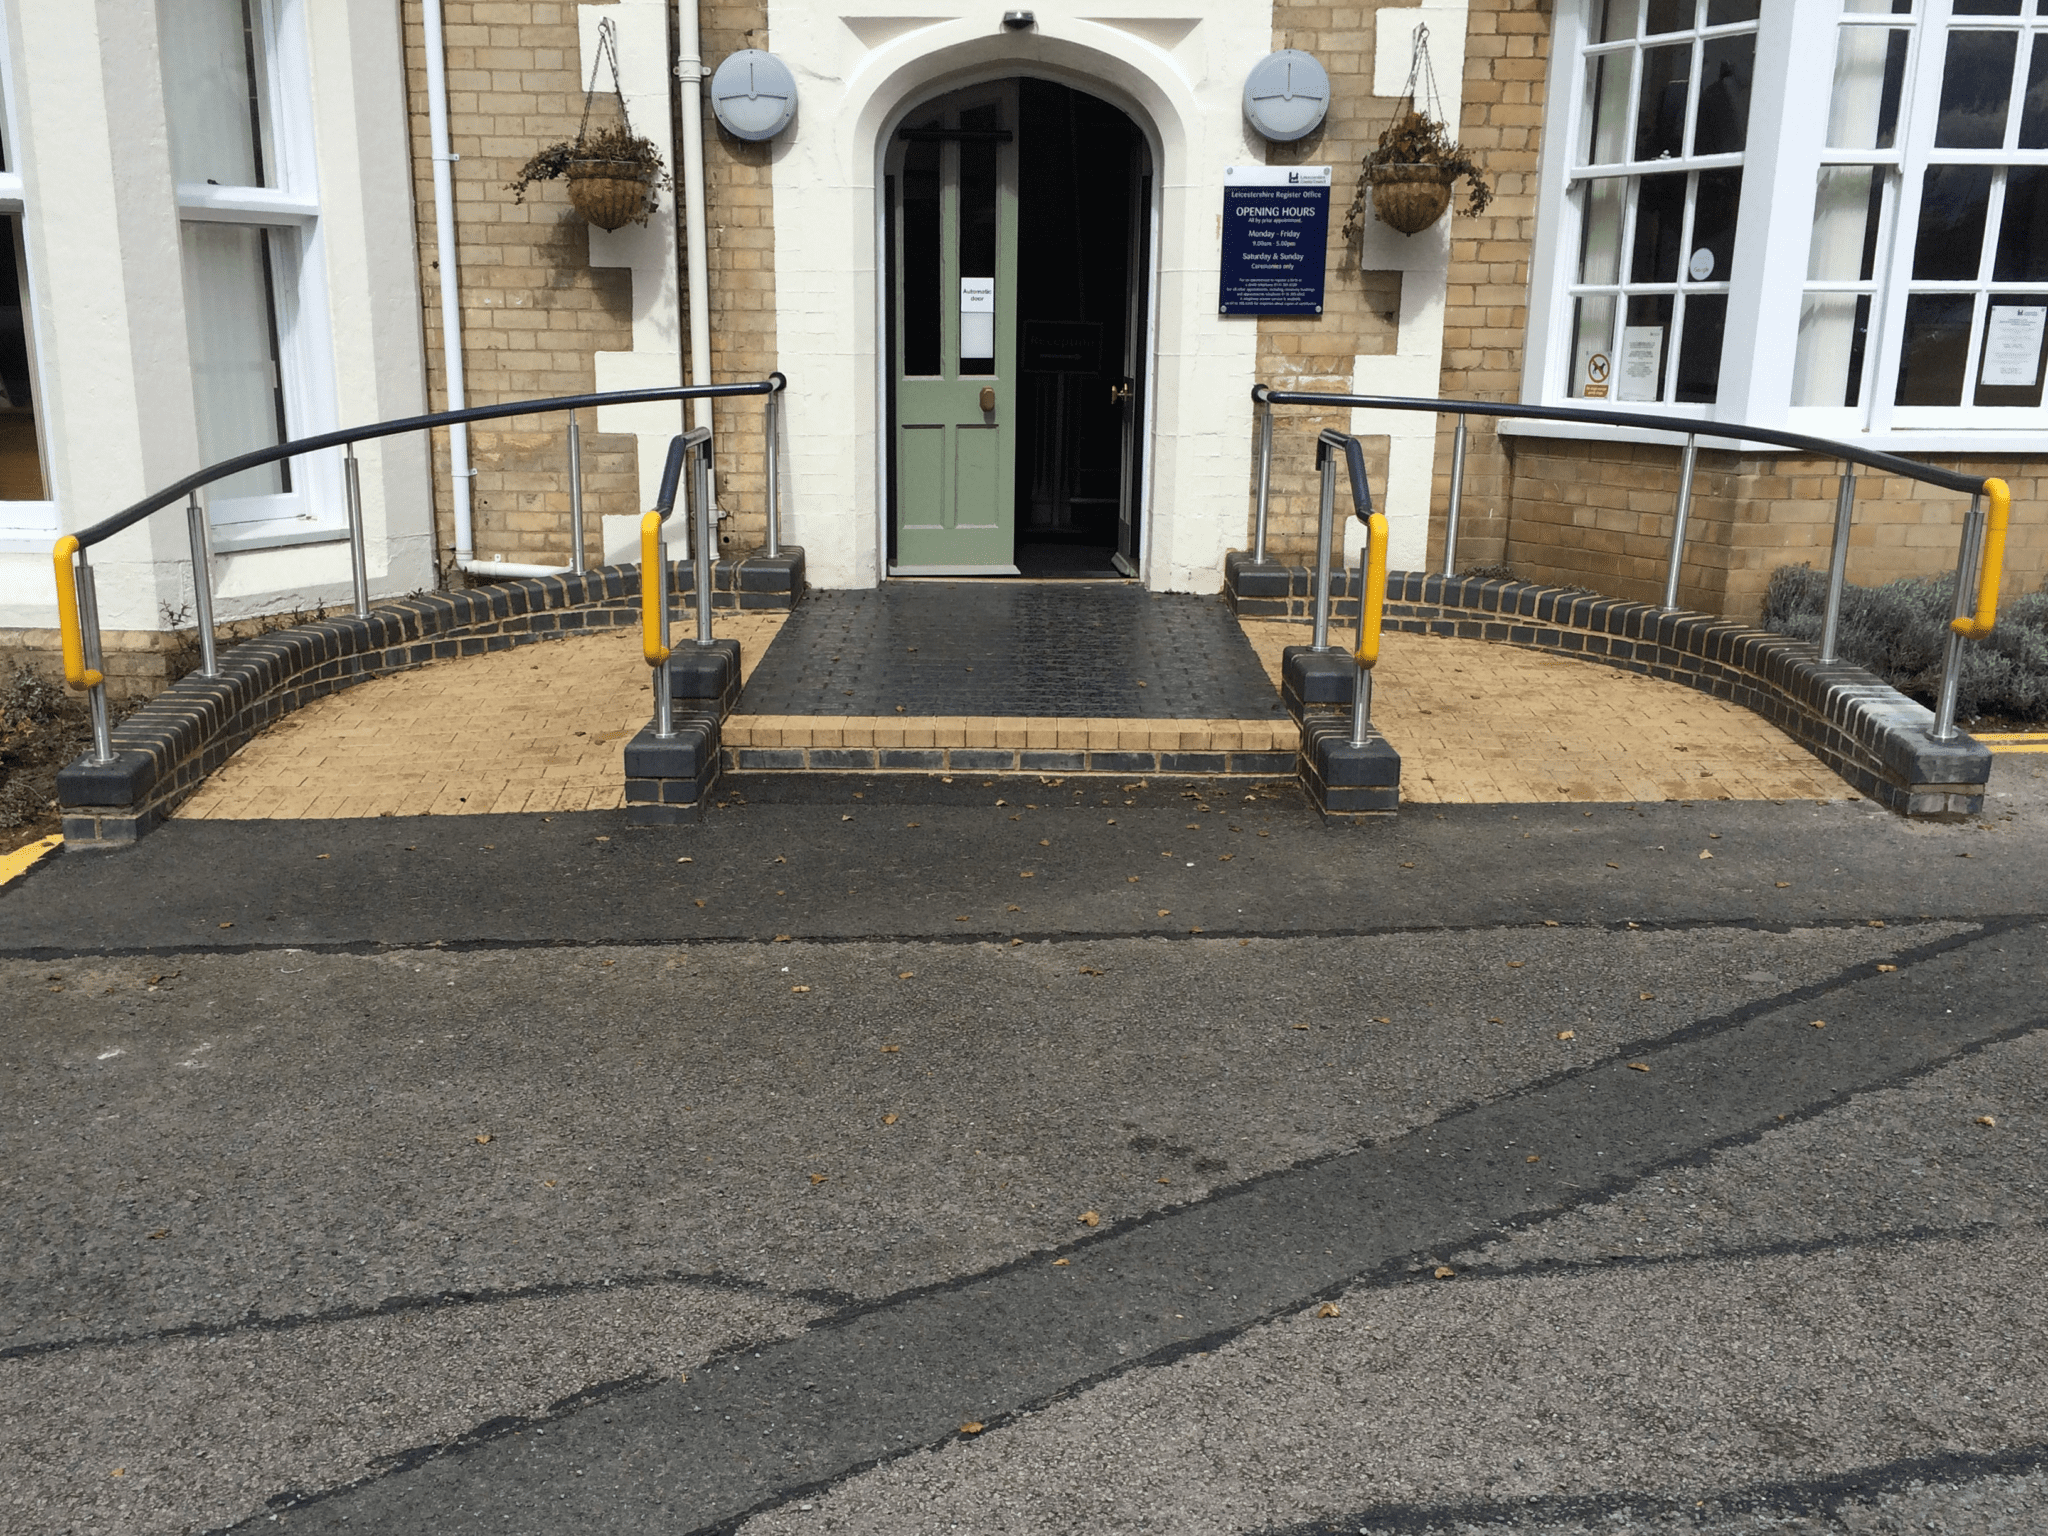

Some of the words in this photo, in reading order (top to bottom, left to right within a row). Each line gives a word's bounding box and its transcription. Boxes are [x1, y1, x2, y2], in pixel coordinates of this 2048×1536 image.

[1276, 191, 1301, 199] Register
[1303, 190, 1322, 198] Office
[1236, 207, 1280, 216] OPENING
[1282, 207, 1316, 216] HOURS
[1248, 230, 1275, 239] Monday
[1280, 230, 1301, 239] Friday
[1242, 253, 1271, 261] Saturday
[1280, 253, 1304, 261] Sunday
